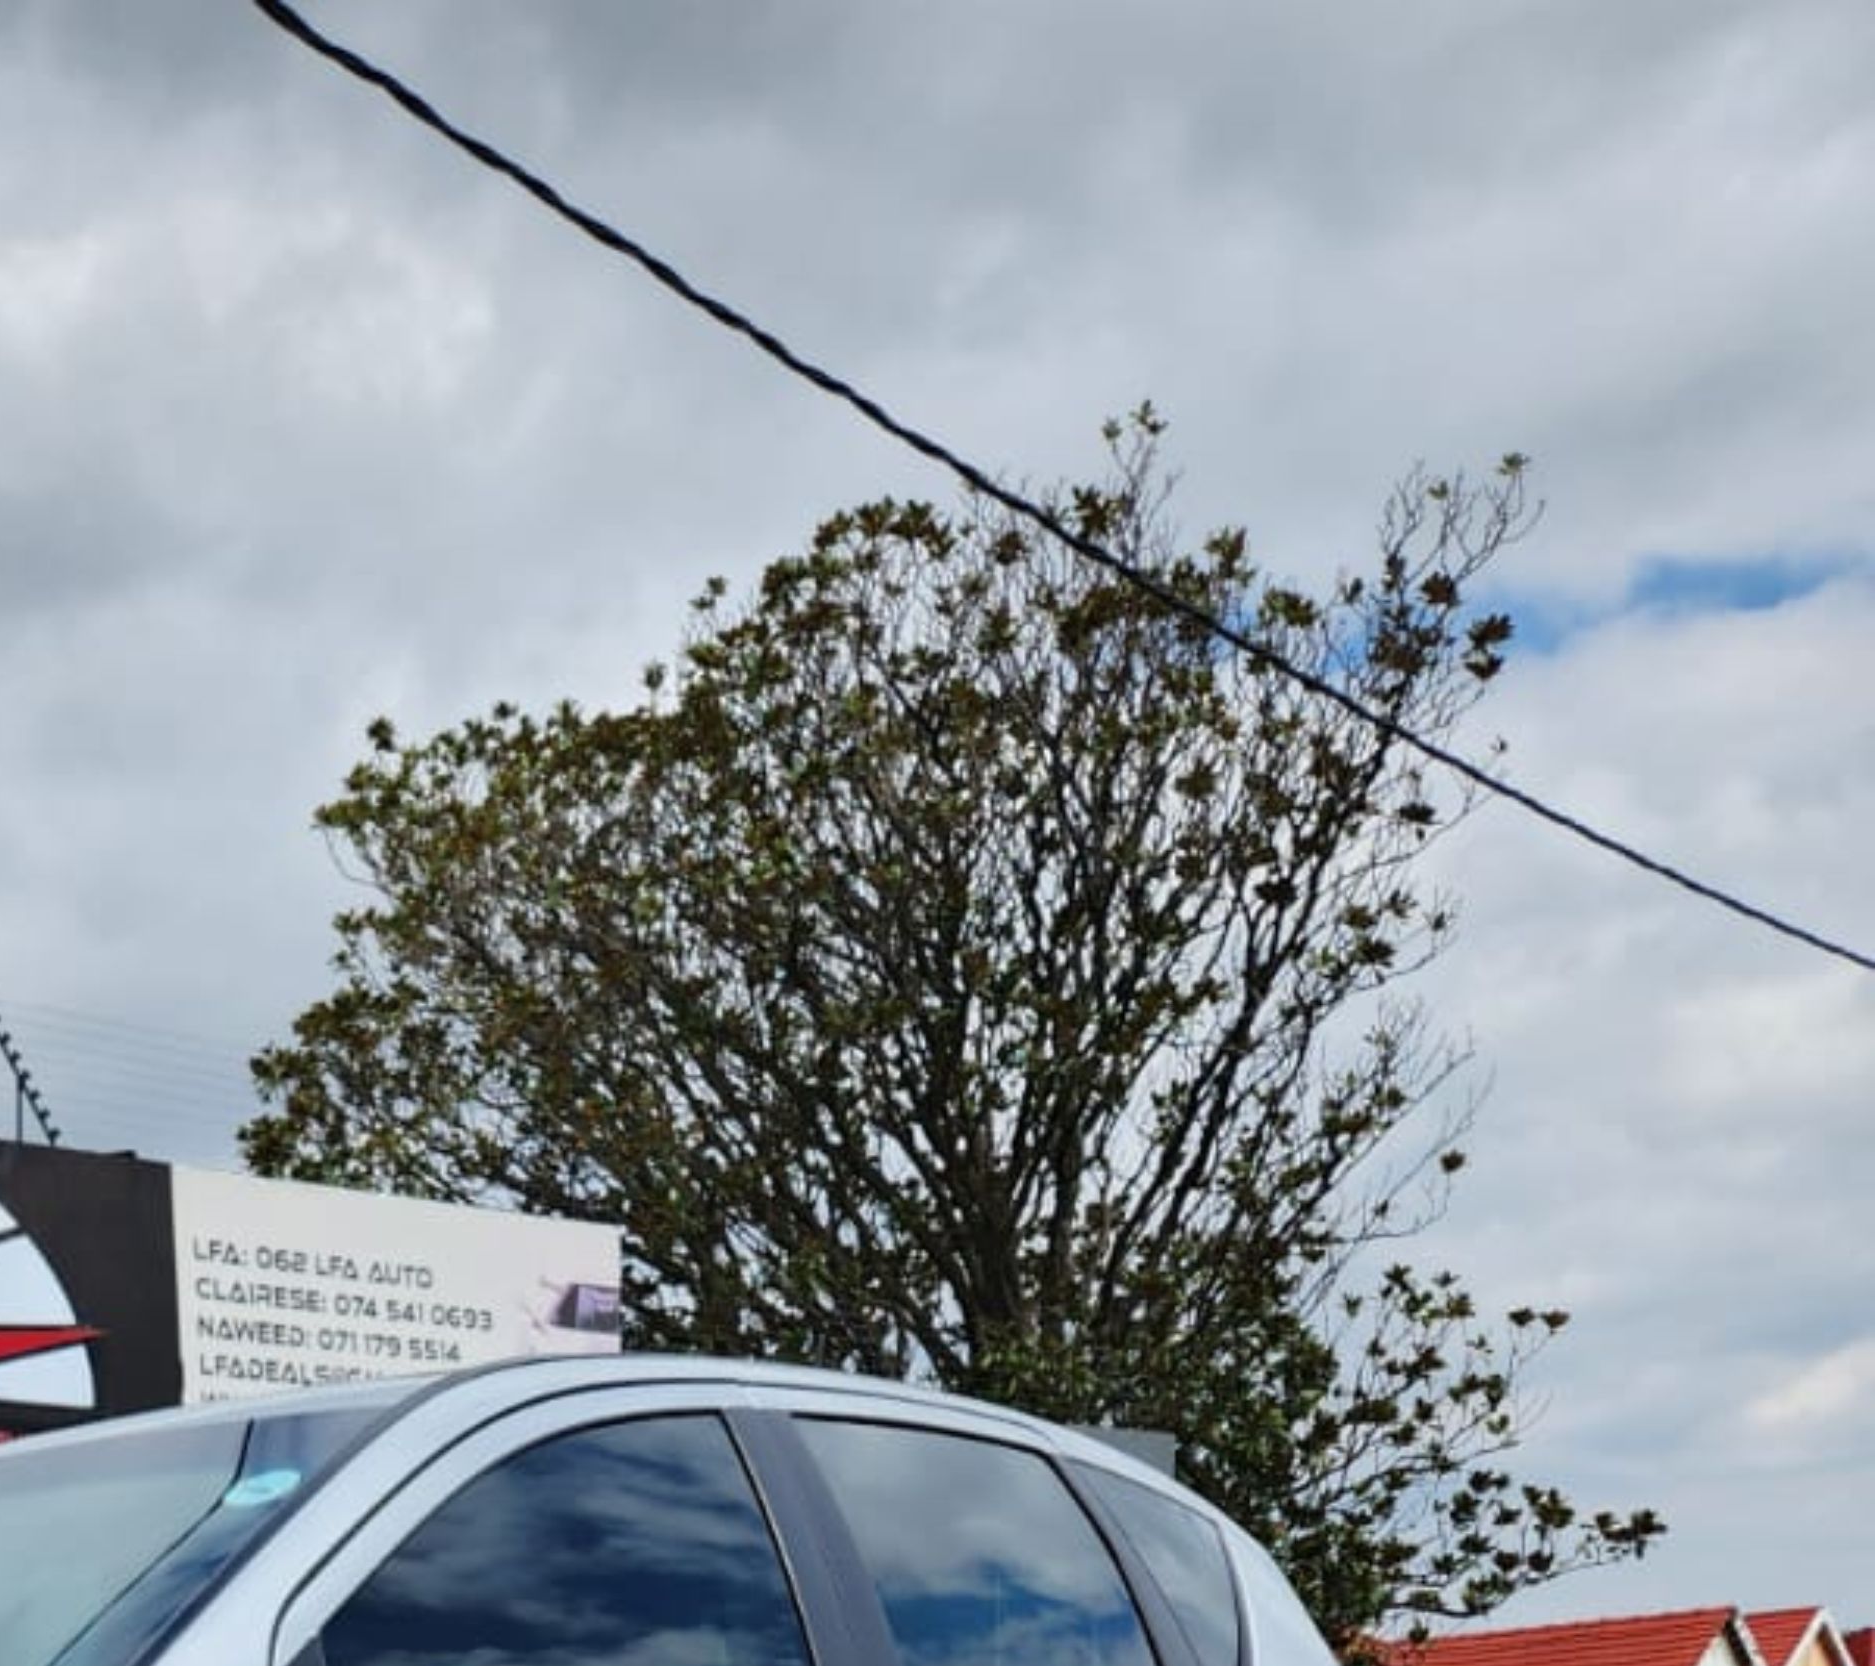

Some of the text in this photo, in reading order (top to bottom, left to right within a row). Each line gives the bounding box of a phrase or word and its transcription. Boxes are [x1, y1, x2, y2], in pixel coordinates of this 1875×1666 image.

[193, 1235, 433, 1290] LFA: 062 LFA AUTO
[195, 1277, 493, 1331] CLAIRESE: 074 541 0693
[197, 1314, 310, 1349] NAWEED:
[318, 1327, 358, 1353] 071
